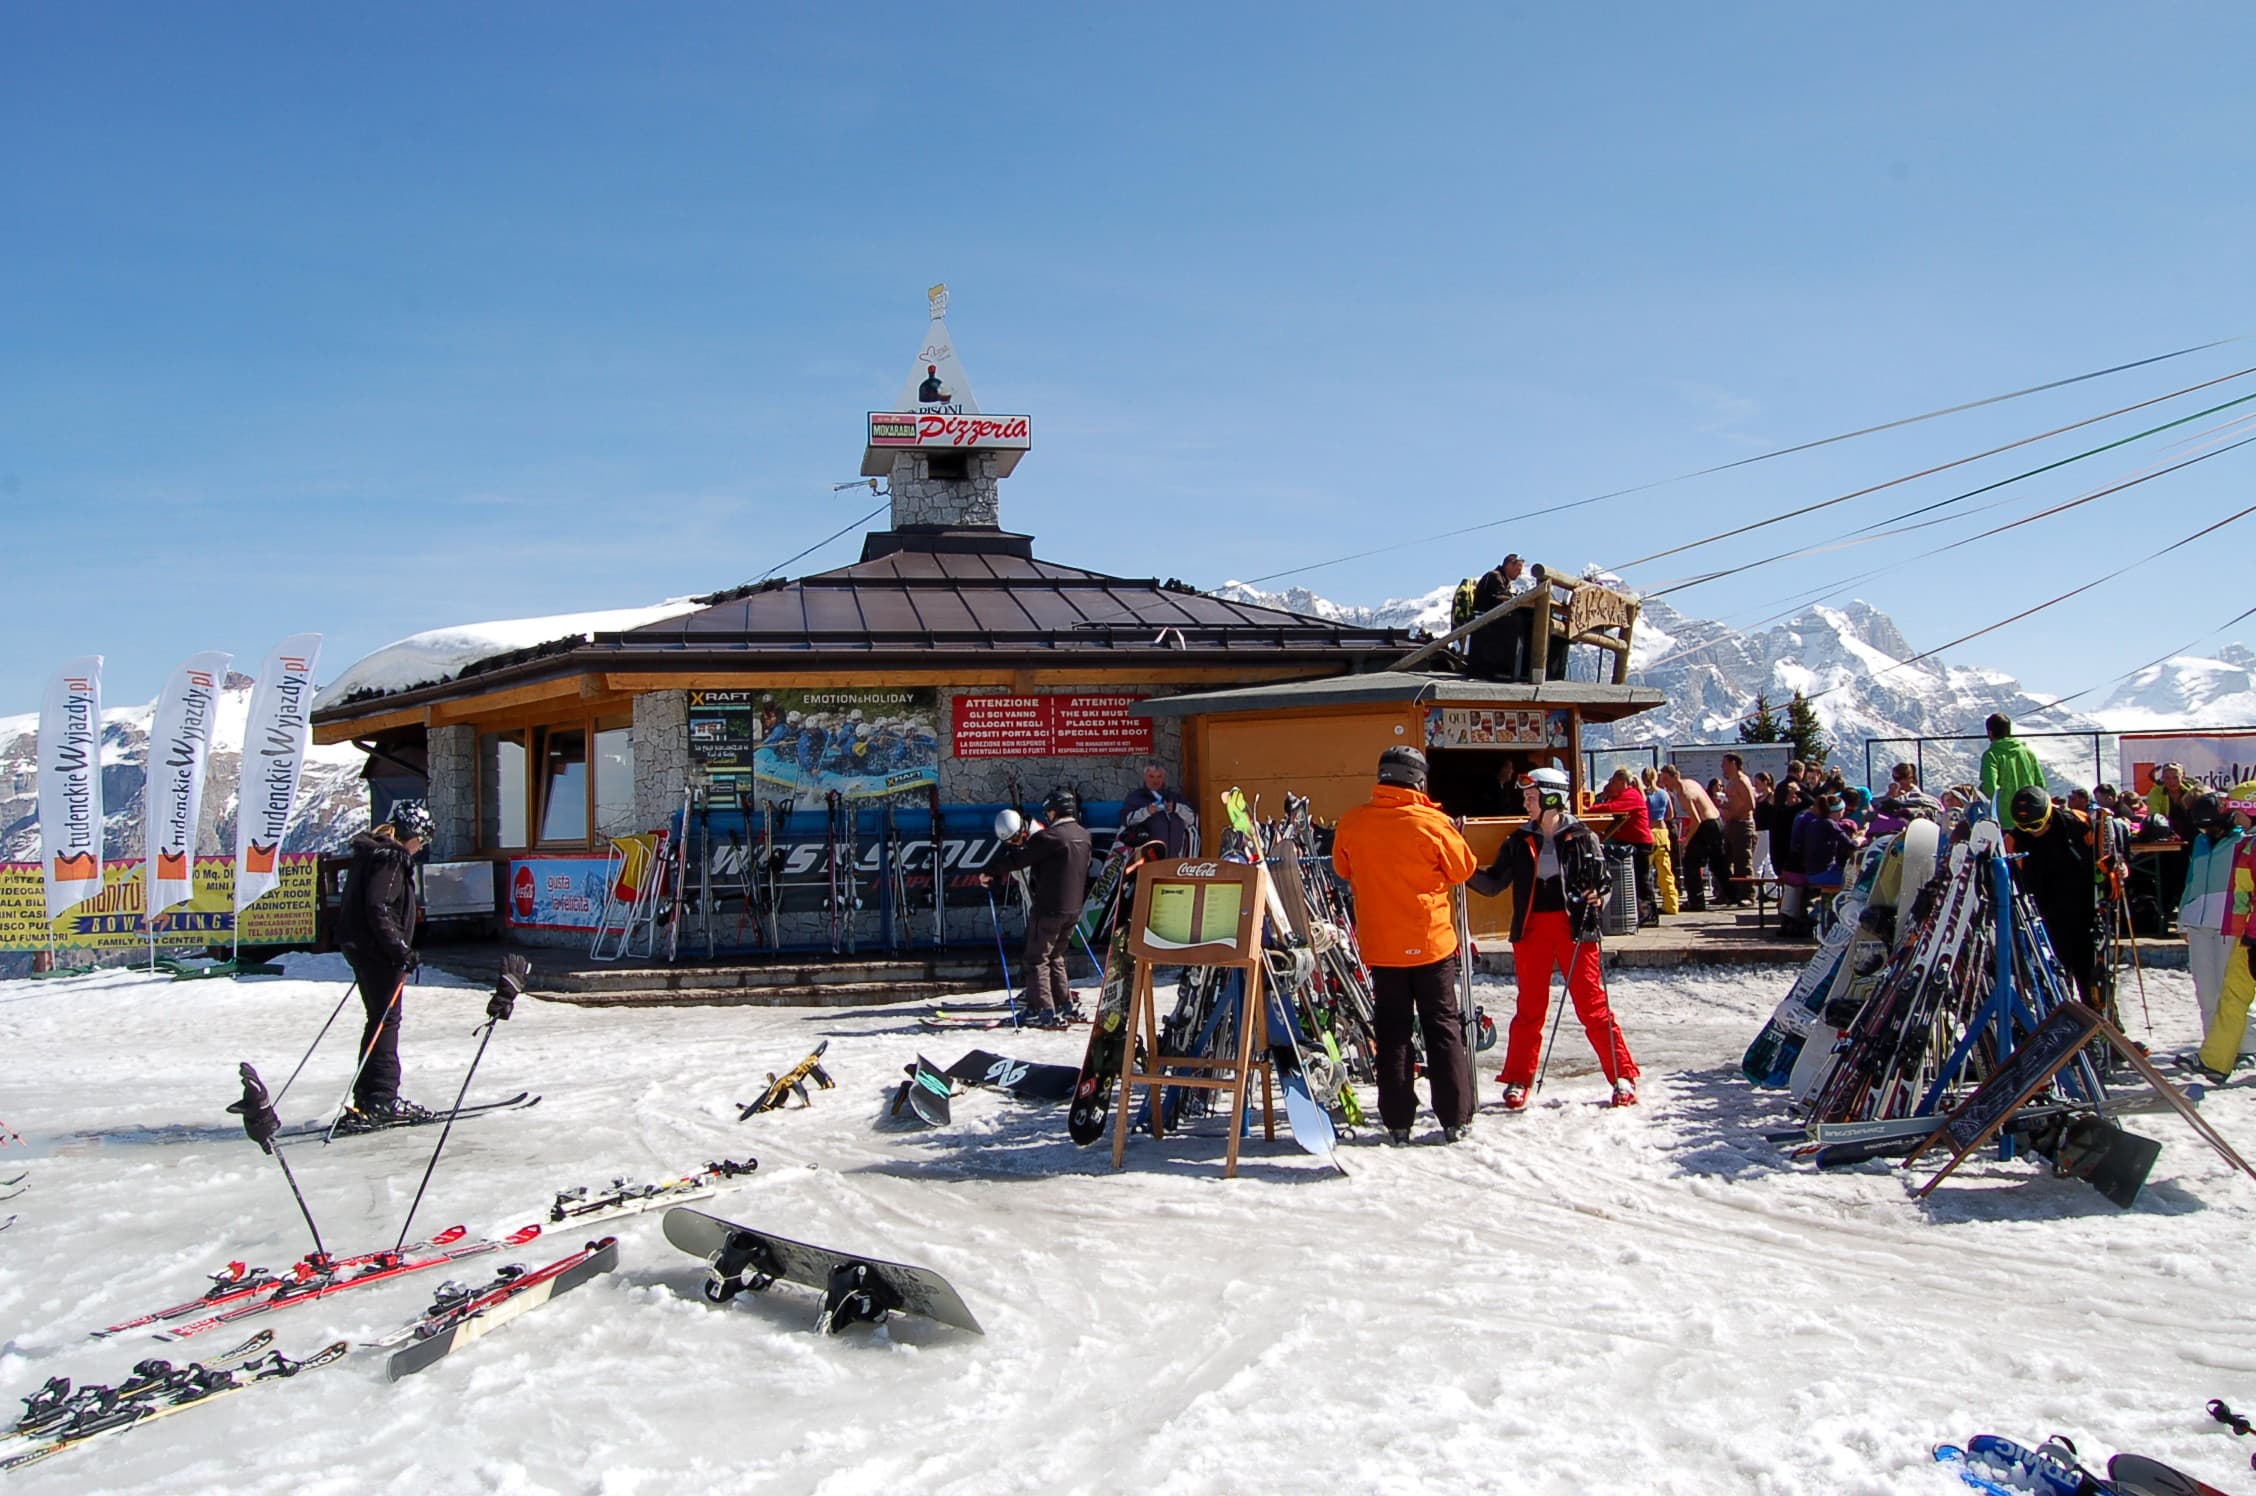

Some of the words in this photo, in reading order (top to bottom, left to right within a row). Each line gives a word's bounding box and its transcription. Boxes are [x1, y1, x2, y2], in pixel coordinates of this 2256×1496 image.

[917, 415, 1028, 446] Pizzeria
[965, 698, 1040, 708] ATTENZIONE
[1060, 710, 1080, 718] THE
[1066, 719, 1105, 727] PLACED
[956, 730, 1000, 738] APPOSITI
[1034, 729, 1050, 737] SCI
[292, 878, 312, 888] CAR
[283, 889, 311, 898] ROOM
[0, 898, 22, 907] ALA
[0, 922, 26, 930] ISCO
[97, 938, 134, 946] FAMILY
[161, 936, 204, 944] CENTER
